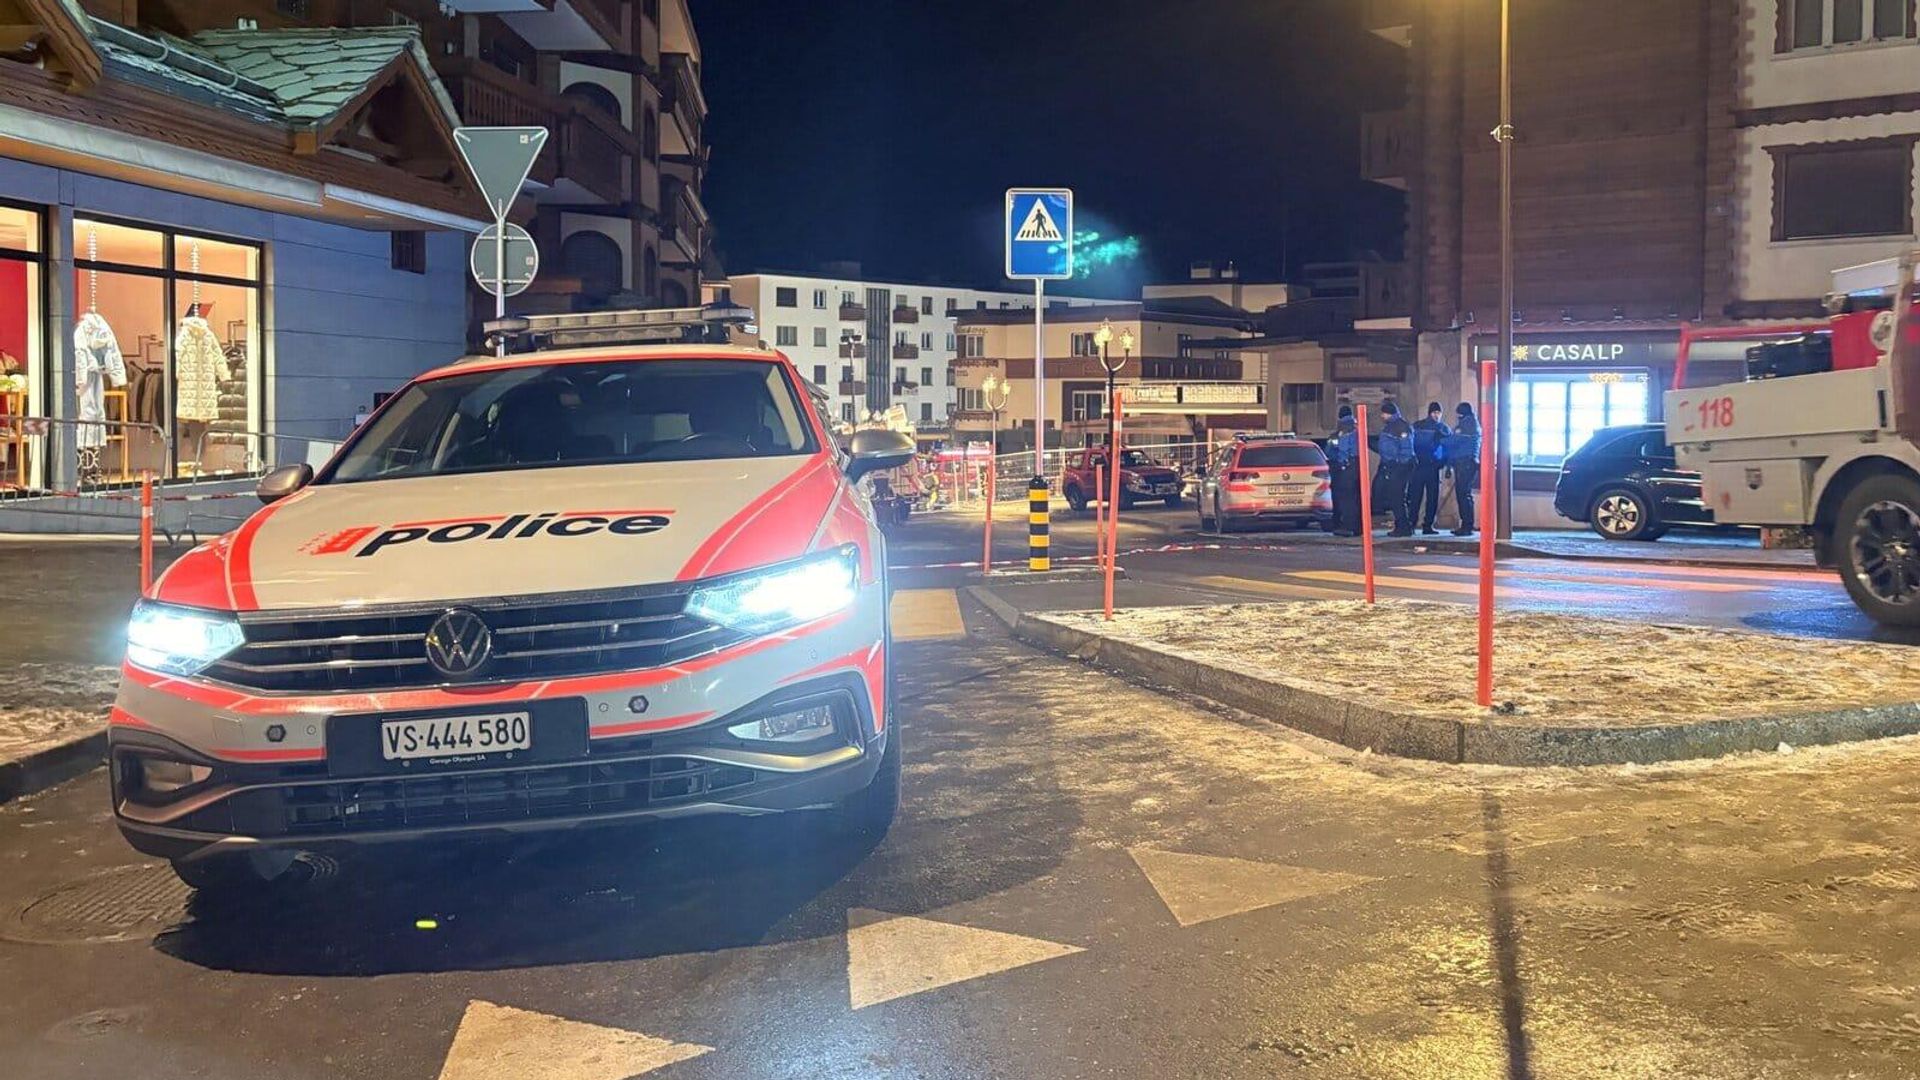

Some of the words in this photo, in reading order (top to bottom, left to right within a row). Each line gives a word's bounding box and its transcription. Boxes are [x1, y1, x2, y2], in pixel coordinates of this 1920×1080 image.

[1537, 343, 1624, 361] CASALP
[1698, 396, 1734, 430] 118
[355, 513, 671, 558] police
